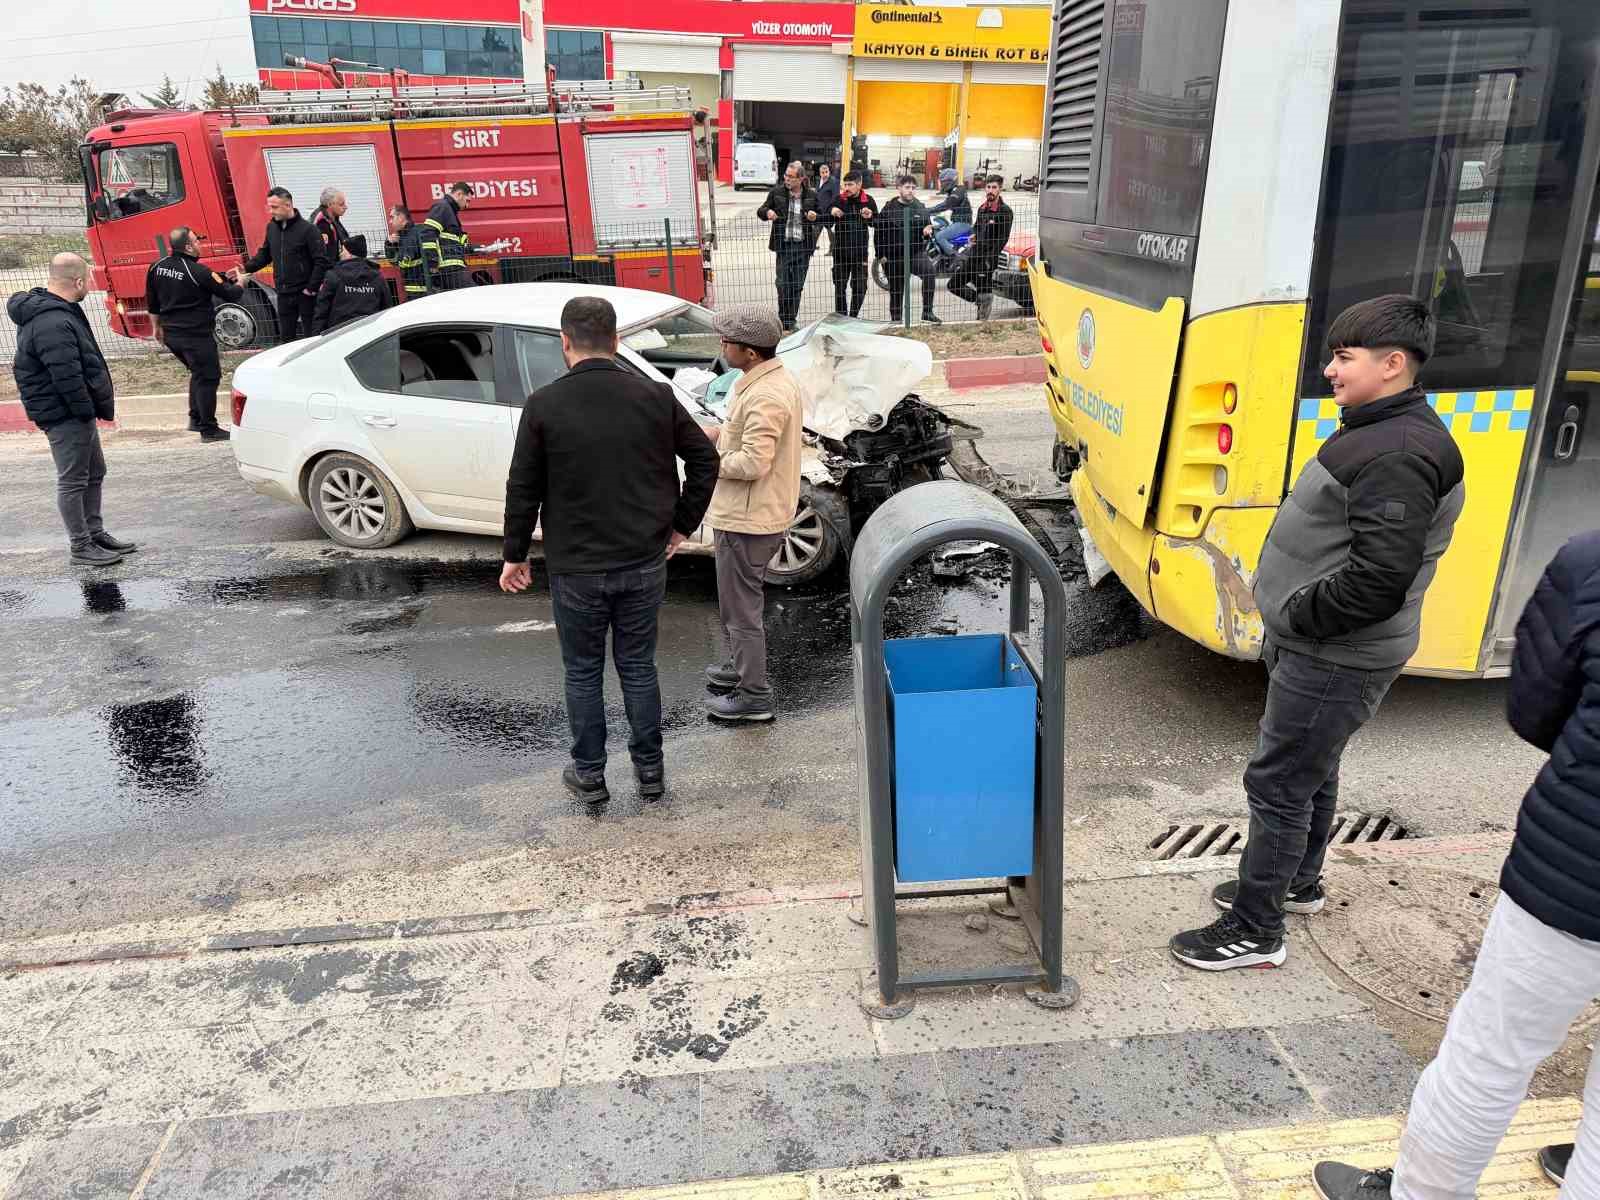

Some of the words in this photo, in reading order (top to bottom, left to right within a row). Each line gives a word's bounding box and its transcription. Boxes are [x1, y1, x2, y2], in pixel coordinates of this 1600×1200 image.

[871, 9, 932, 24] Continental
[752, 20, 780, 35] YÜZER
[783, 22, 832, 36] OTOMOTİV
[863, 43, 925, 57] KAMYON
[930, 46, 939, 57] &
[945, 45, 989, 59] BİNEK
[996, 48, 1025, 60] ROT
[1136, 233, 1188, 262] OTOKAR
